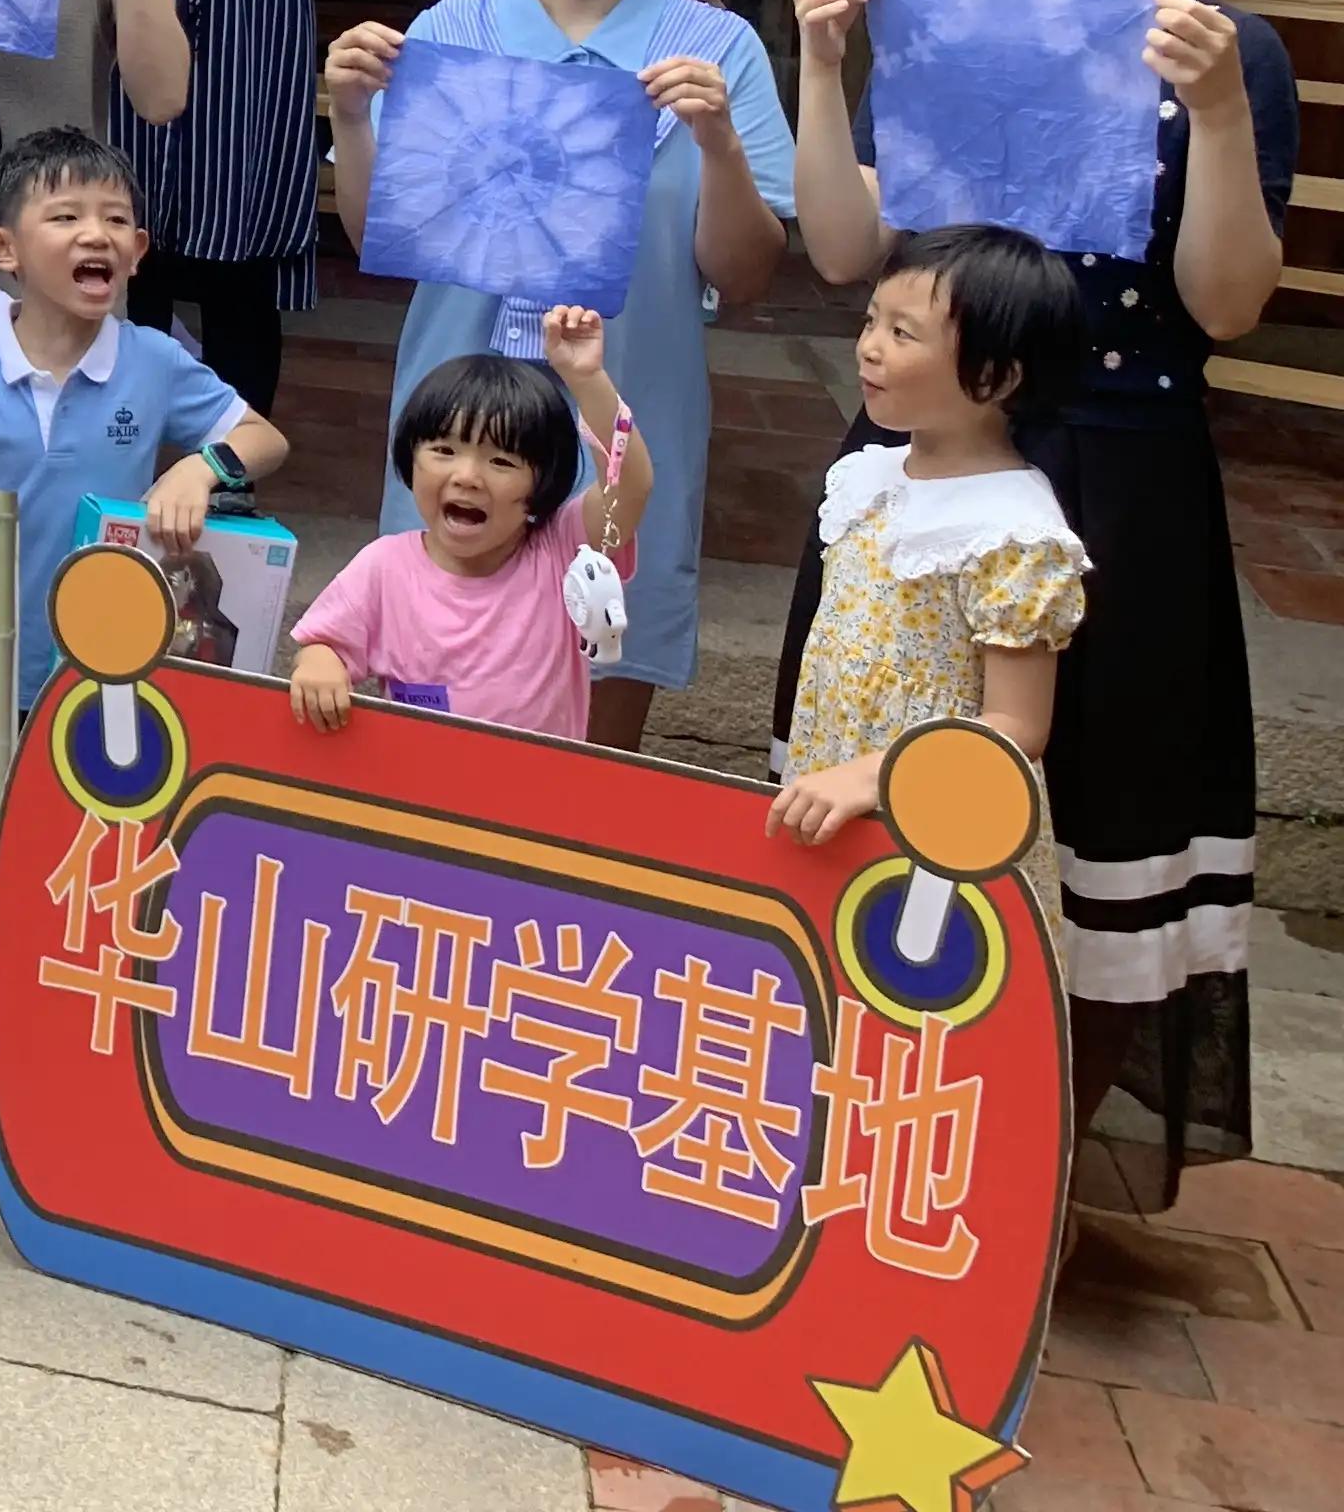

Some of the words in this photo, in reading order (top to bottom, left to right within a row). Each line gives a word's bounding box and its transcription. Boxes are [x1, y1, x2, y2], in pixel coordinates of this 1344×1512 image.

[37, 809, 984, 1283] 华山研学基地
